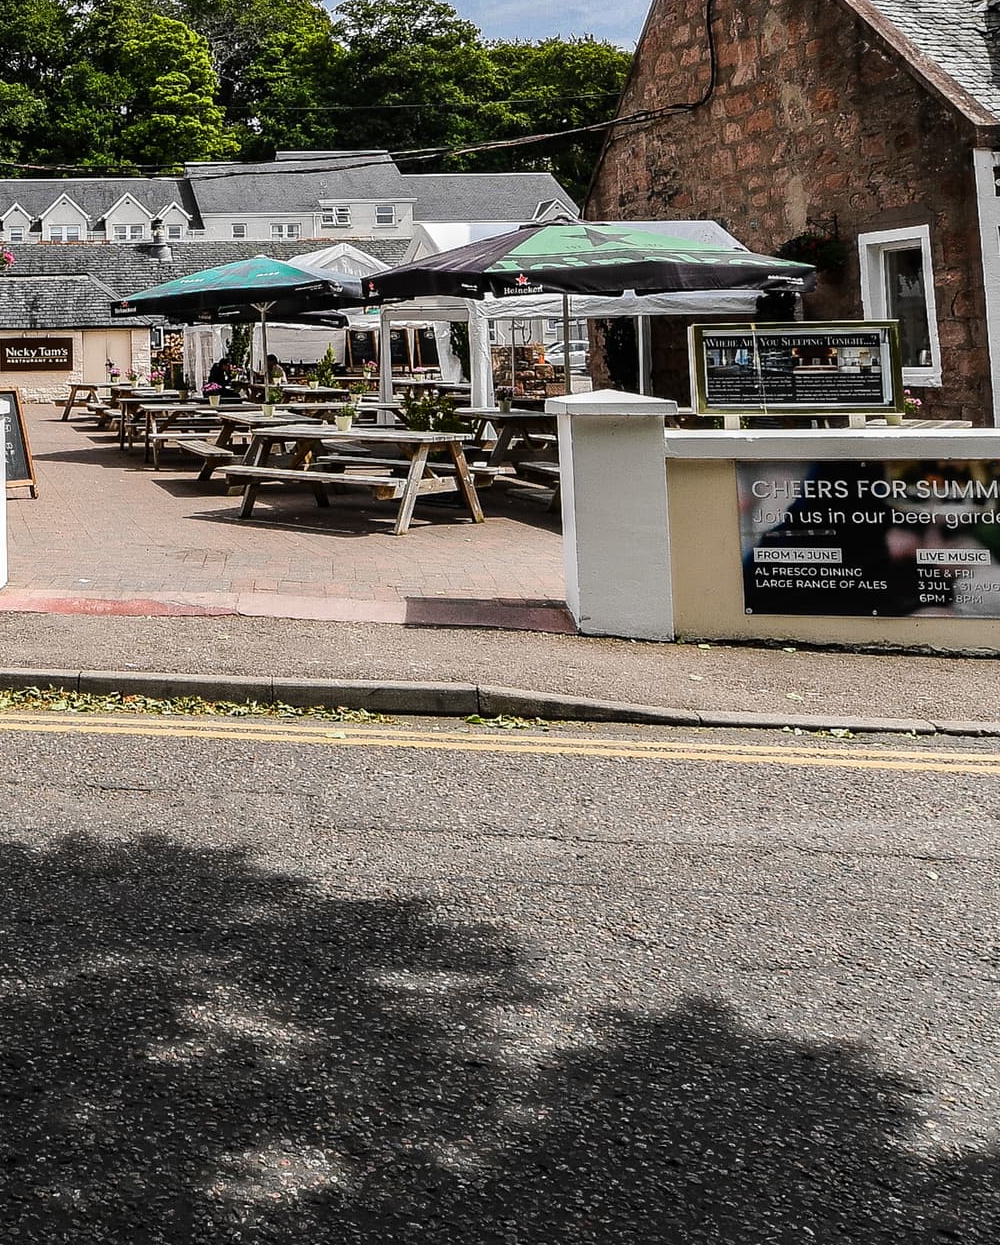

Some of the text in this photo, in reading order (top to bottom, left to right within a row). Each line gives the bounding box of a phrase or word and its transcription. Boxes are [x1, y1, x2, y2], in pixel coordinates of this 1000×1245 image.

[504, 284, 543, 295] Heineken
[740, 338, 754, 347] AR
[760, 337, 778, 346] YOU
[781, 337, 823, 347] SLEEPING
[5, 347, 37, 358] Nicky
[752, 480, 999, 499] CHEERS FOR SUMM
[753, 508, 793, 524] Join
[799, 511, 823, 524] us
[828, 508, 846, 524] in
[852, 511, 886, 524] our
[891, 508, 938, 524] beer
[757, 550, 838, 560] FROM 14 JUNE
[919, 552, 987, 562] LIVE MUSIC
[755, 567, 863, 577] AL FRESCO DINING
[916, 568, 974, 579] TUE & FRI
[756, 579, 888, 590] LARGE RANGE OF ALES
[917, 581, 925, 590] 3
[927, 581, 951, 591] JUL
[919, 594, 945, 603] 6PM
[955, 594, 984, 604] 8PM
